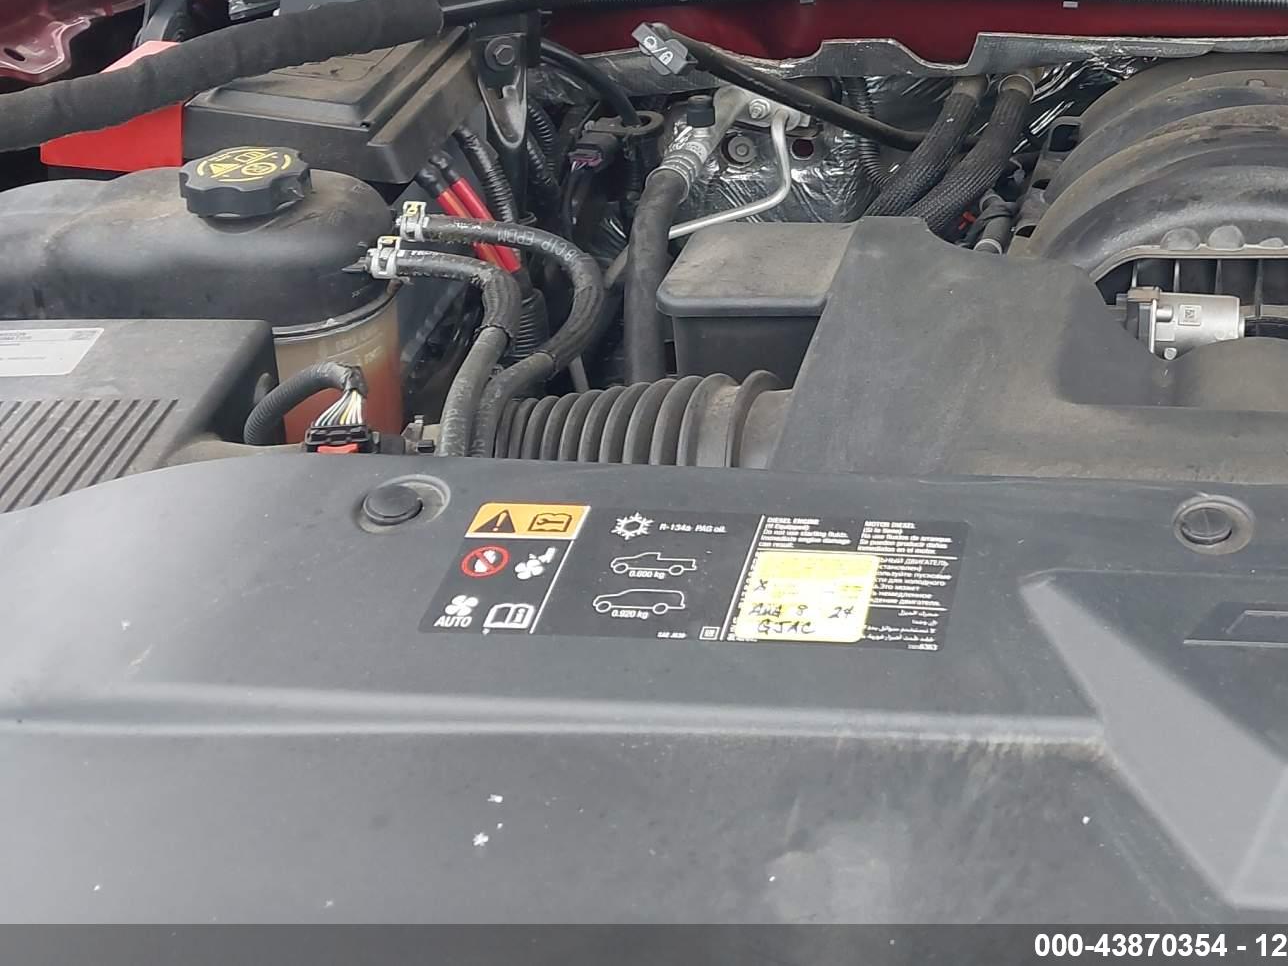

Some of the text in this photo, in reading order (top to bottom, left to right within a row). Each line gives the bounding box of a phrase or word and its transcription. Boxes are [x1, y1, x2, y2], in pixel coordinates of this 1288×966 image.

[659, 523, 692, 532] R-134a
[654, 571, 665, 580] kg
[611, 609, 648, 619] 0.920 kg
[434, 616, 472, 628] AUTO
